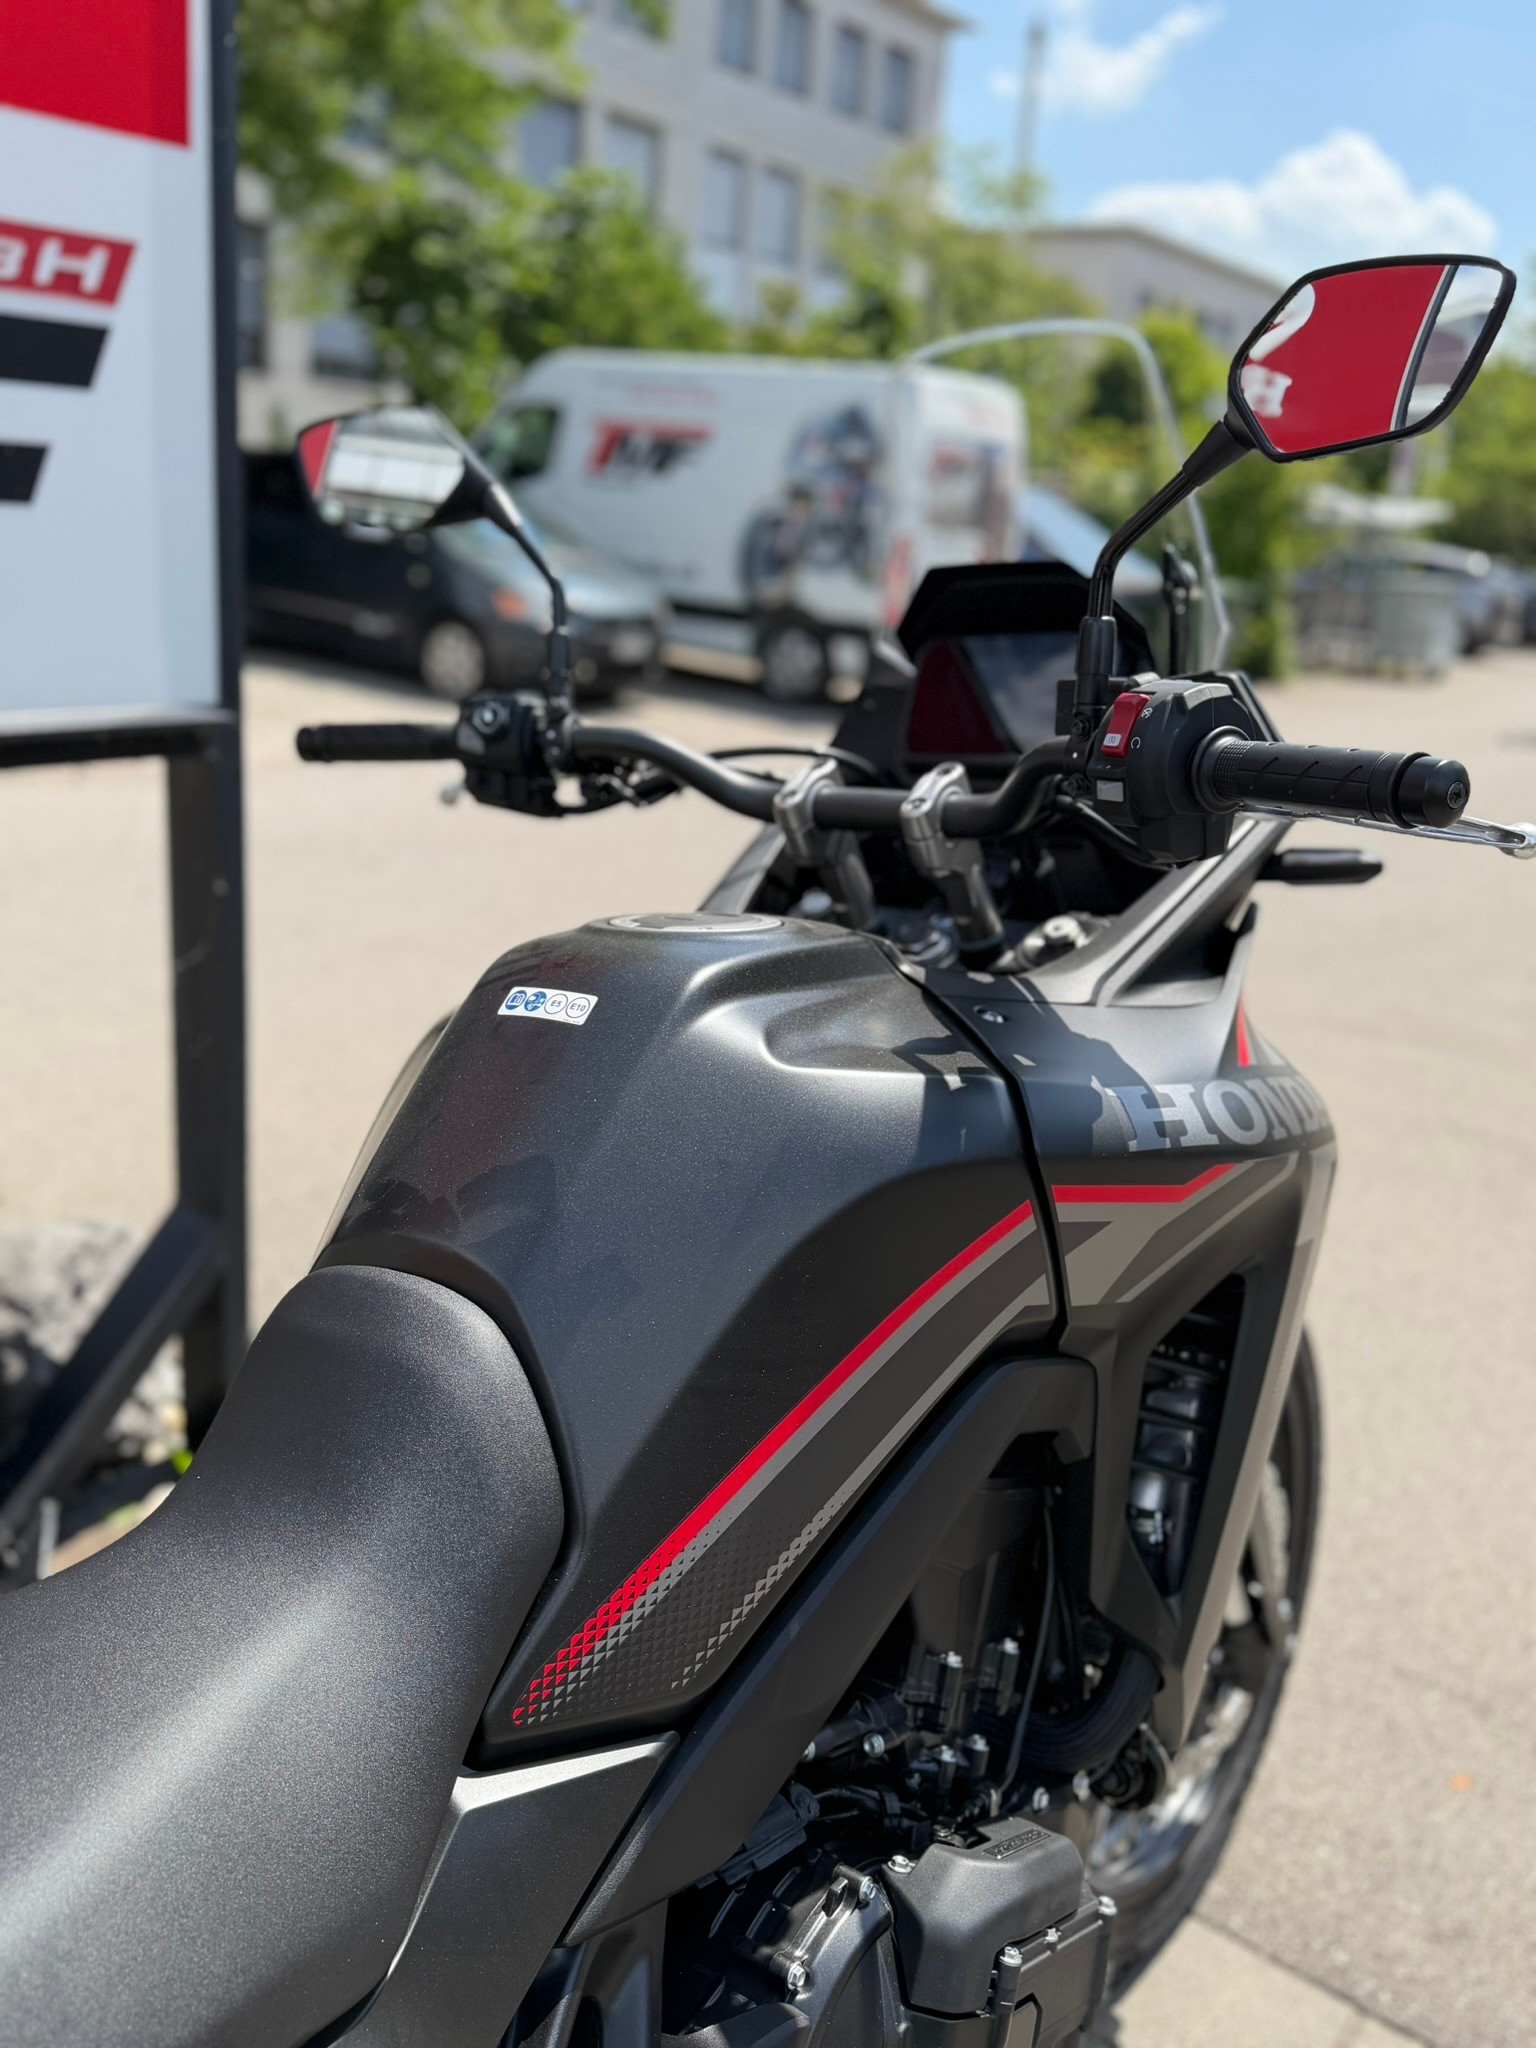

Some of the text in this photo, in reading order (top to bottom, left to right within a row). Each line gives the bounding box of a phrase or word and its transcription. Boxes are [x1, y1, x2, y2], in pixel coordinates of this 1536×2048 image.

[551, 999, 587, 1012] E5 E10
[1108, 1075, 1328, 1152] HOND
